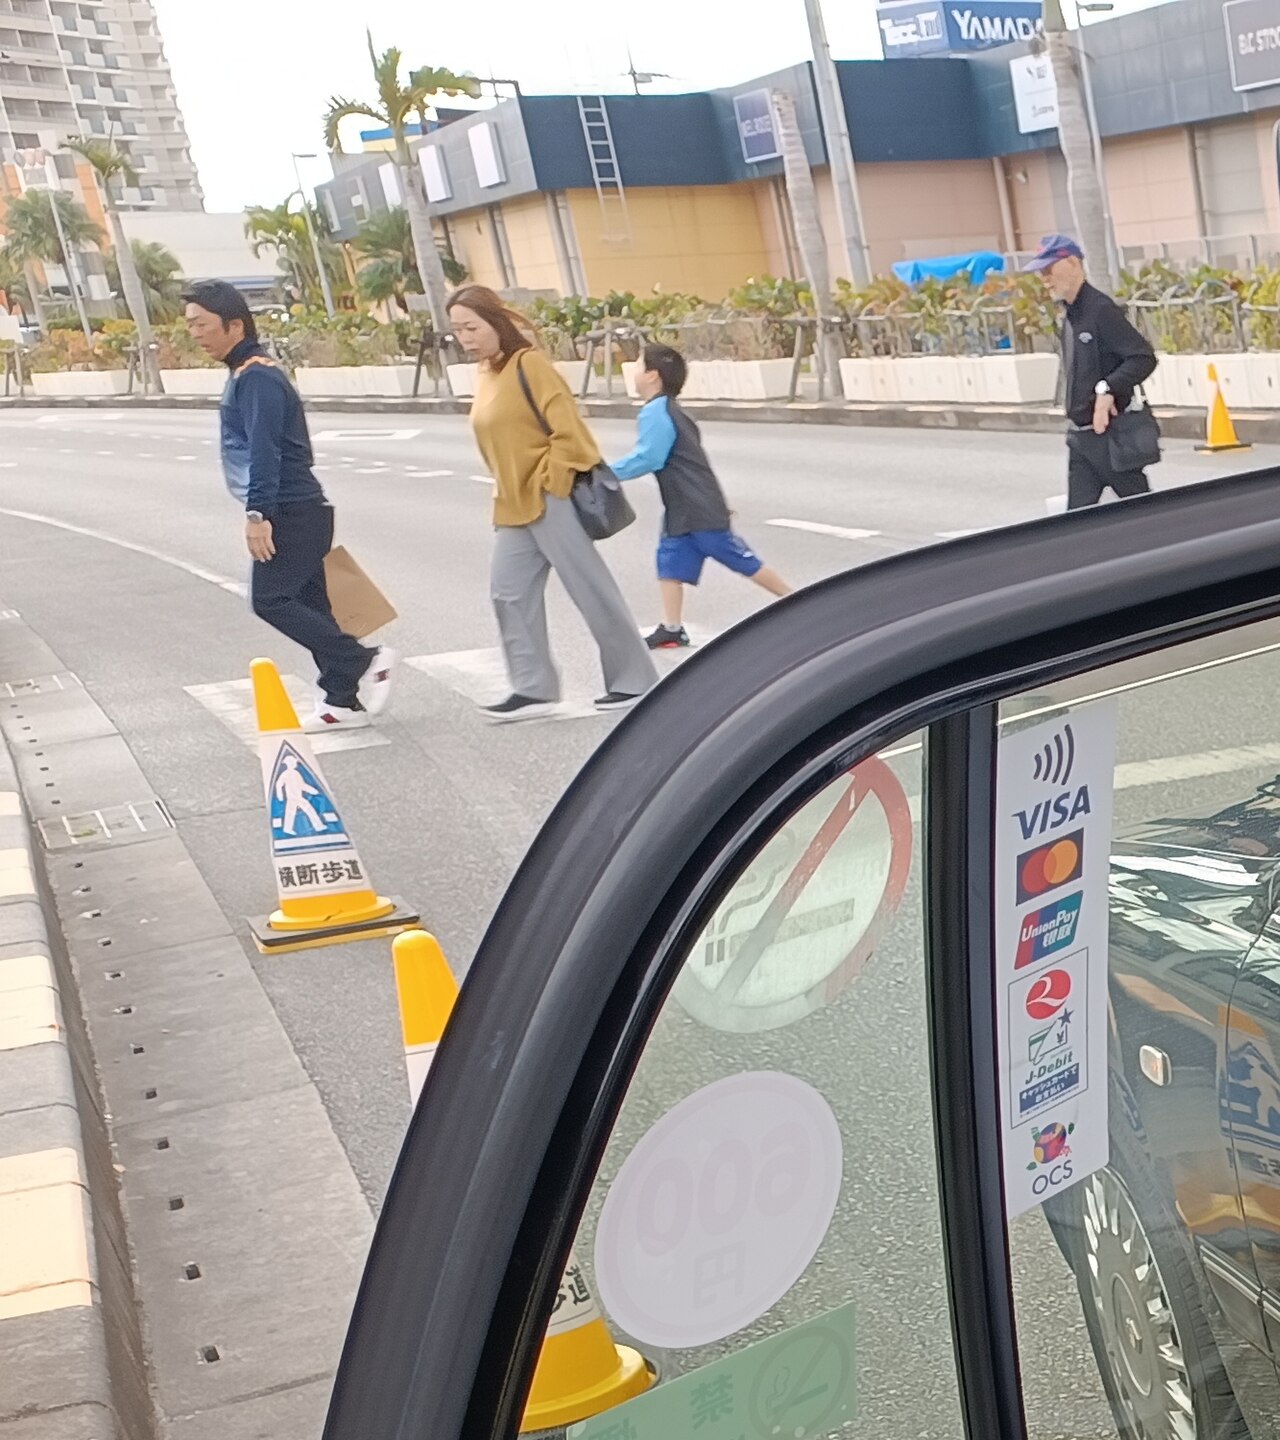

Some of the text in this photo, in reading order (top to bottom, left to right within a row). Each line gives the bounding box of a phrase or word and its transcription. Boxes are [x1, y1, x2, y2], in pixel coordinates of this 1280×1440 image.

[1011, 784, 1091, 840] VISA
[279, 859, 363, 888] 横断歩道
[1021, 907, 1079, 943] UnionPay
[1025, 1050, 1074, 1085] J-Debit
[1032, 1159, 1074, 1195] OCS
